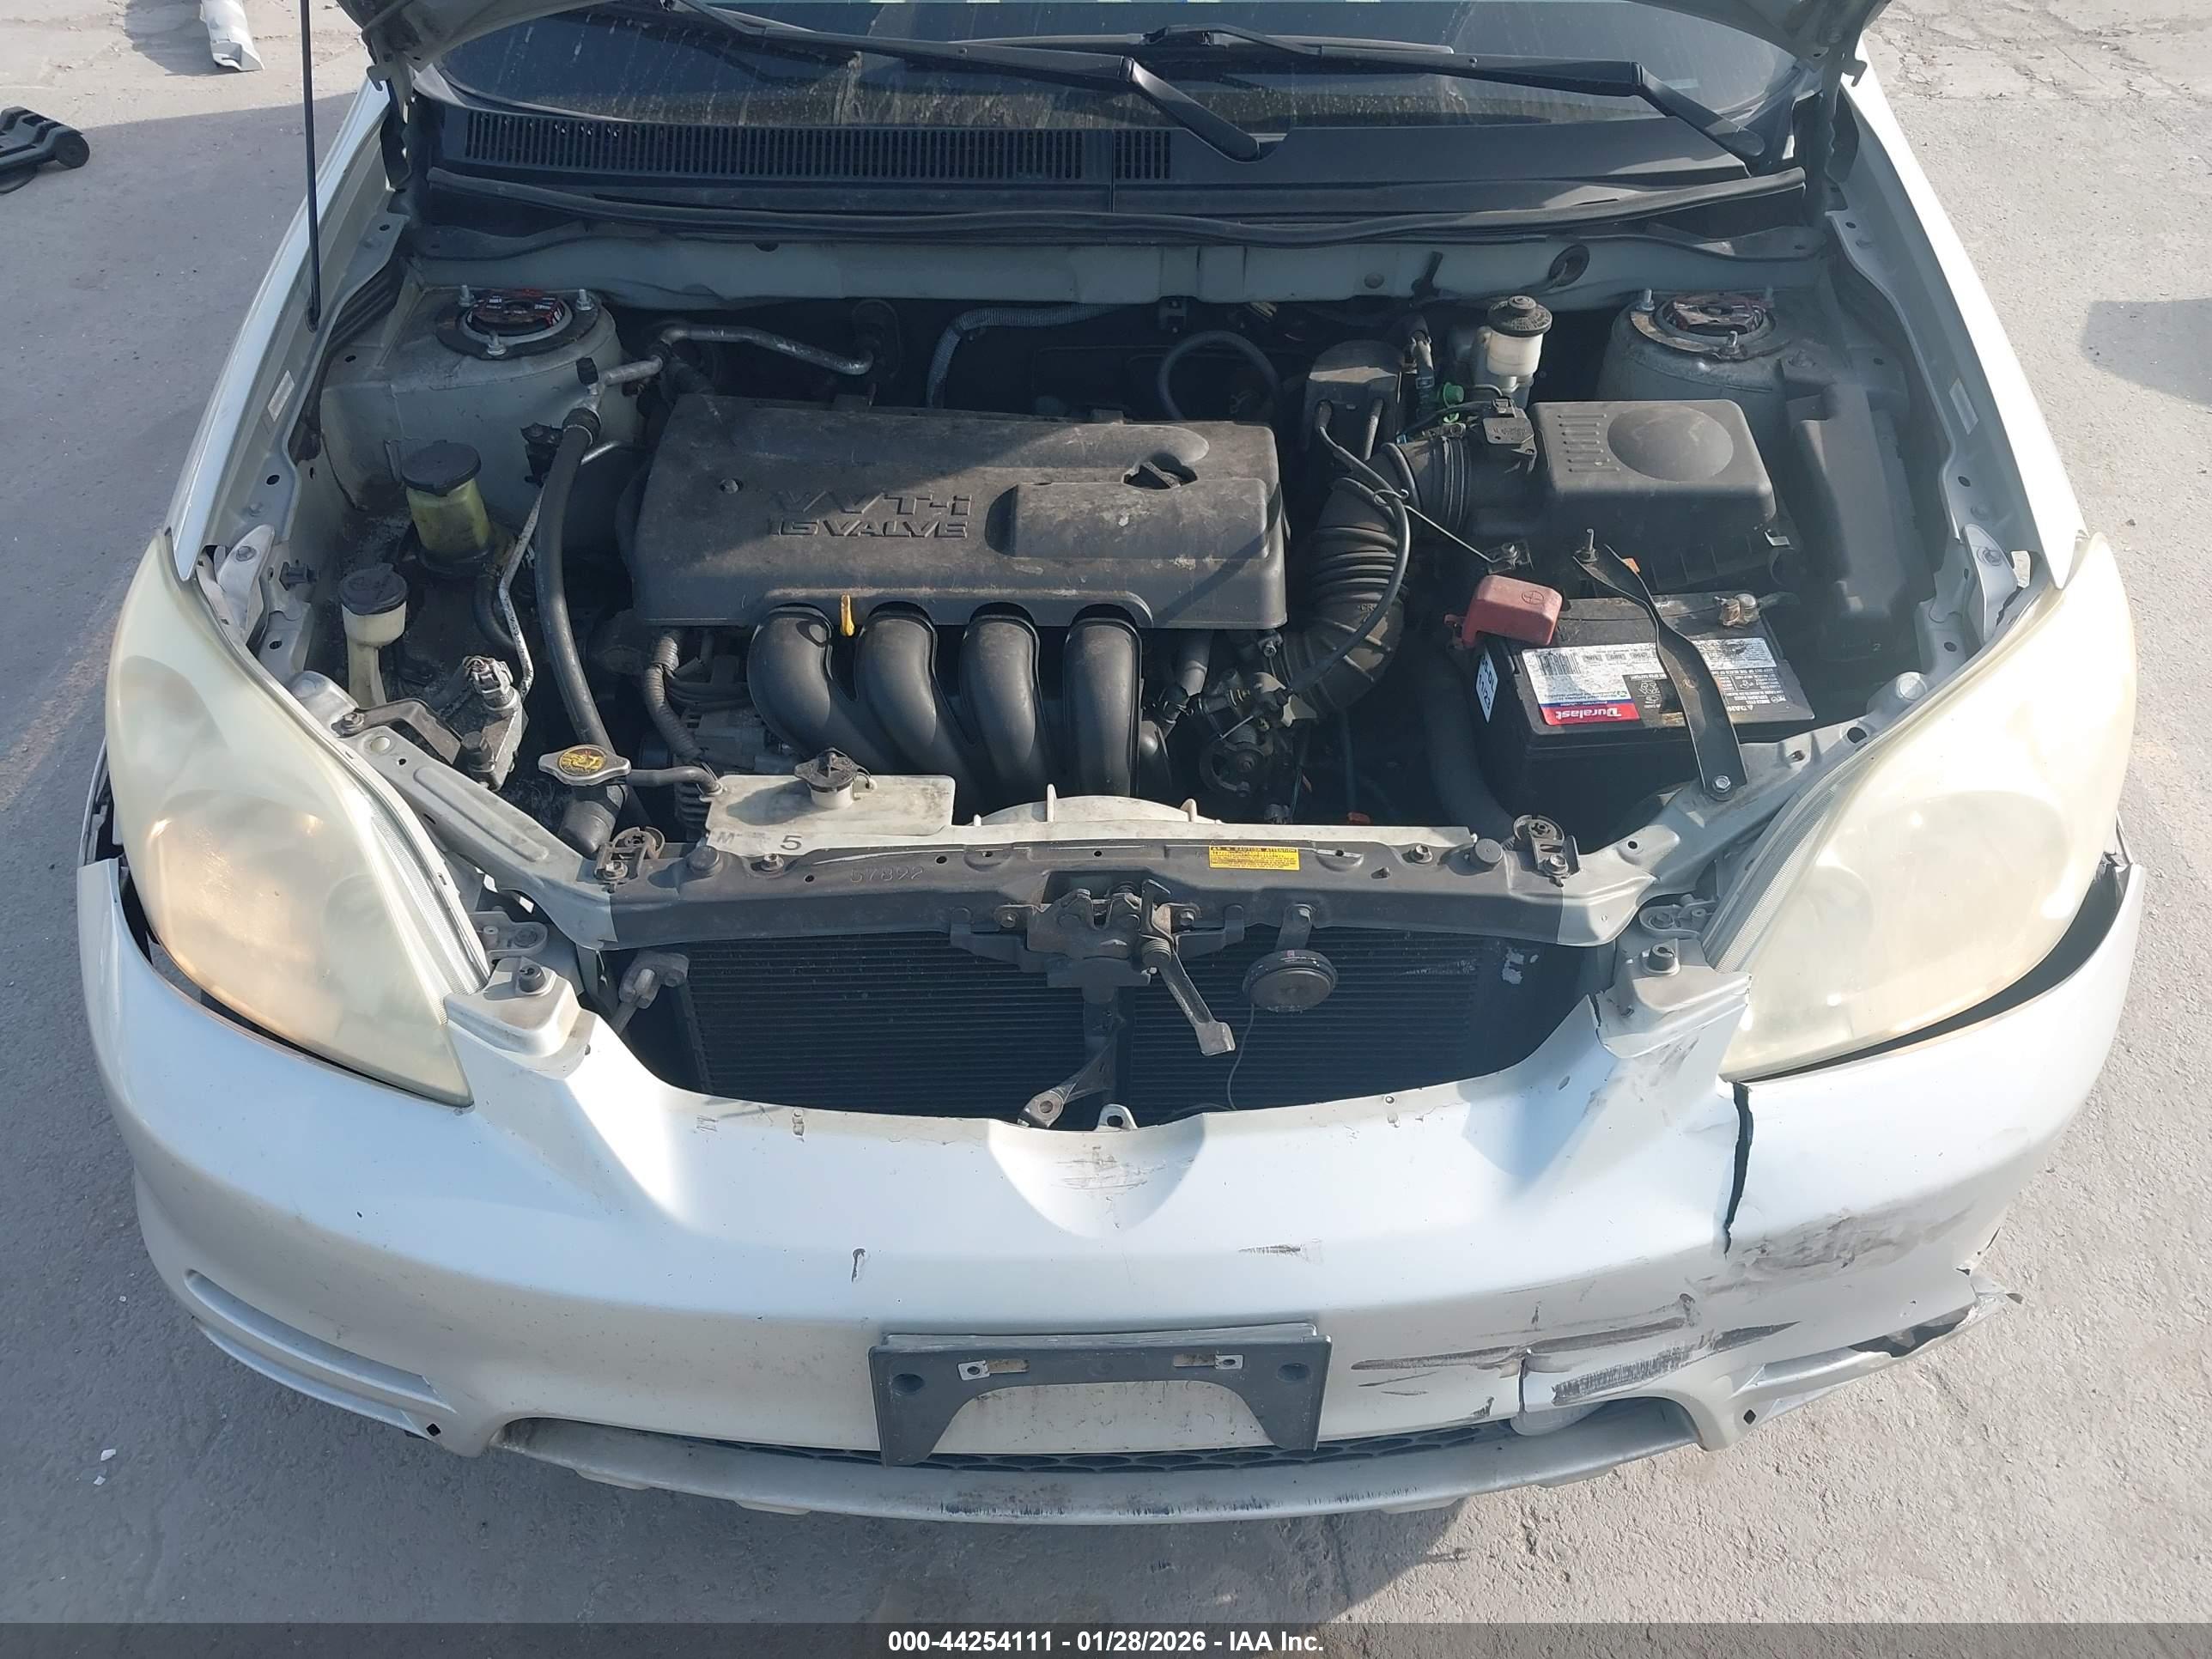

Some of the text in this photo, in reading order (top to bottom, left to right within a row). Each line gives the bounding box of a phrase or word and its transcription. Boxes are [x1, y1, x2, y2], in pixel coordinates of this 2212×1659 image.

[823, 519, 969, 538] VALVE
[1479, 673, 1491, 710] 11/23
[1555, 708, 1622, 720] Duralast
[780, 835, 803, 850] 5
[851, 866, 925, 883] 57892
